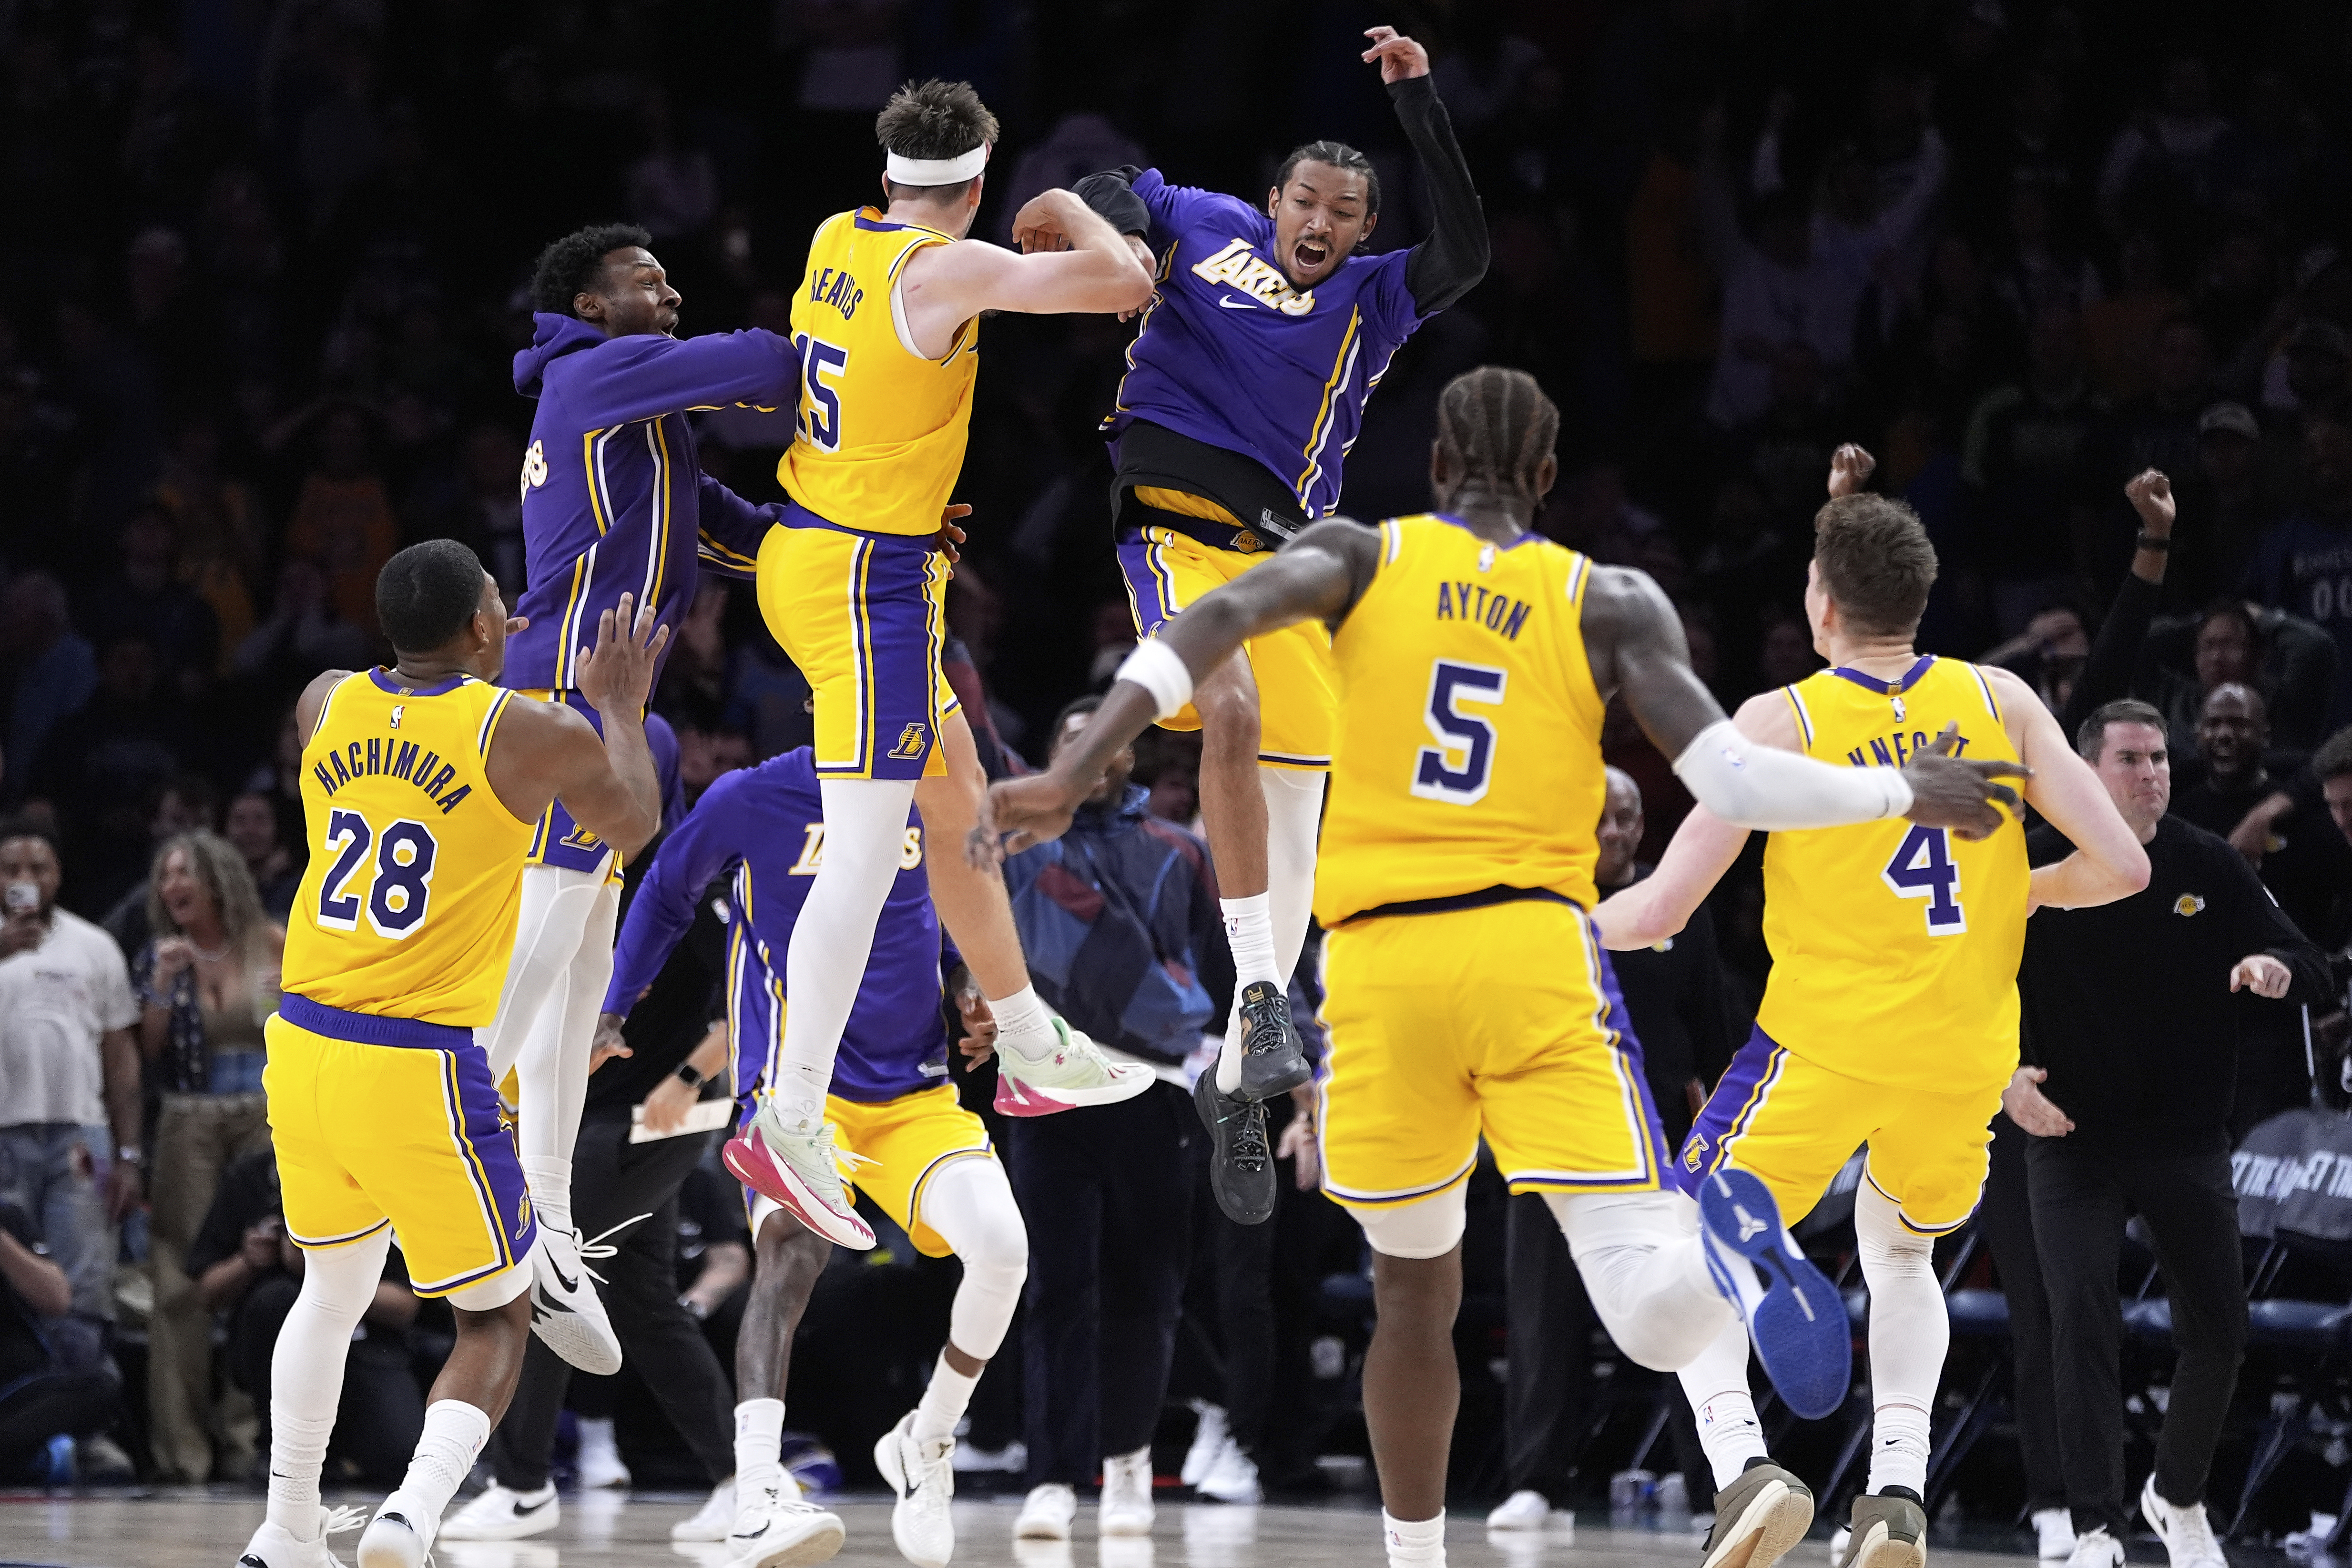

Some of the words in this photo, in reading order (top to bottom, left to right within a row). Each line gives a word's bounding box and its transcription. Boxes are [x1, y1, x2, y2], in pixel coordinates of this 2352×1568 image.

[1437, 581, 1532, 641] AYTON
[314, 738, 472, 815] HACHIMURA
[1410, 656, 1508, 806] 5
[316, 806, 439, 941] 28
[1880, 823, 1967, 937] 4
